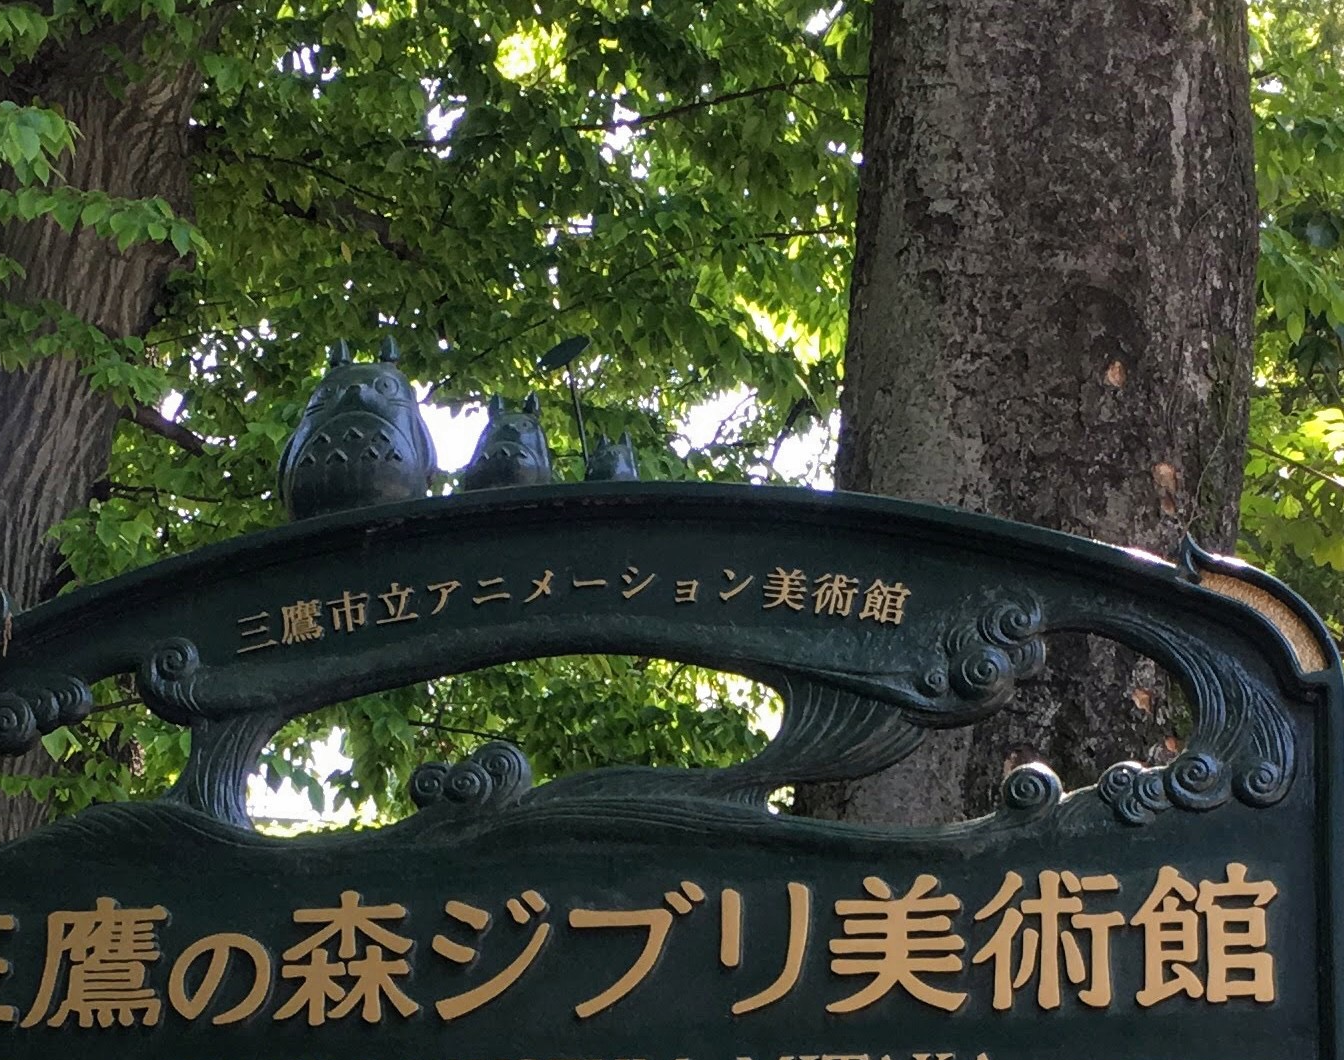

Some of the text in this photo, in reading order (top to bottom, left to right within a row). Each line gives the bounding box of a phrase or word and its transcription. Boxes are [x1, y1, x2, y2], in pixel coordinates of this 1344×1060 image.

[235, 565, 912, 655] 三鷹市立アニメーション美術館
